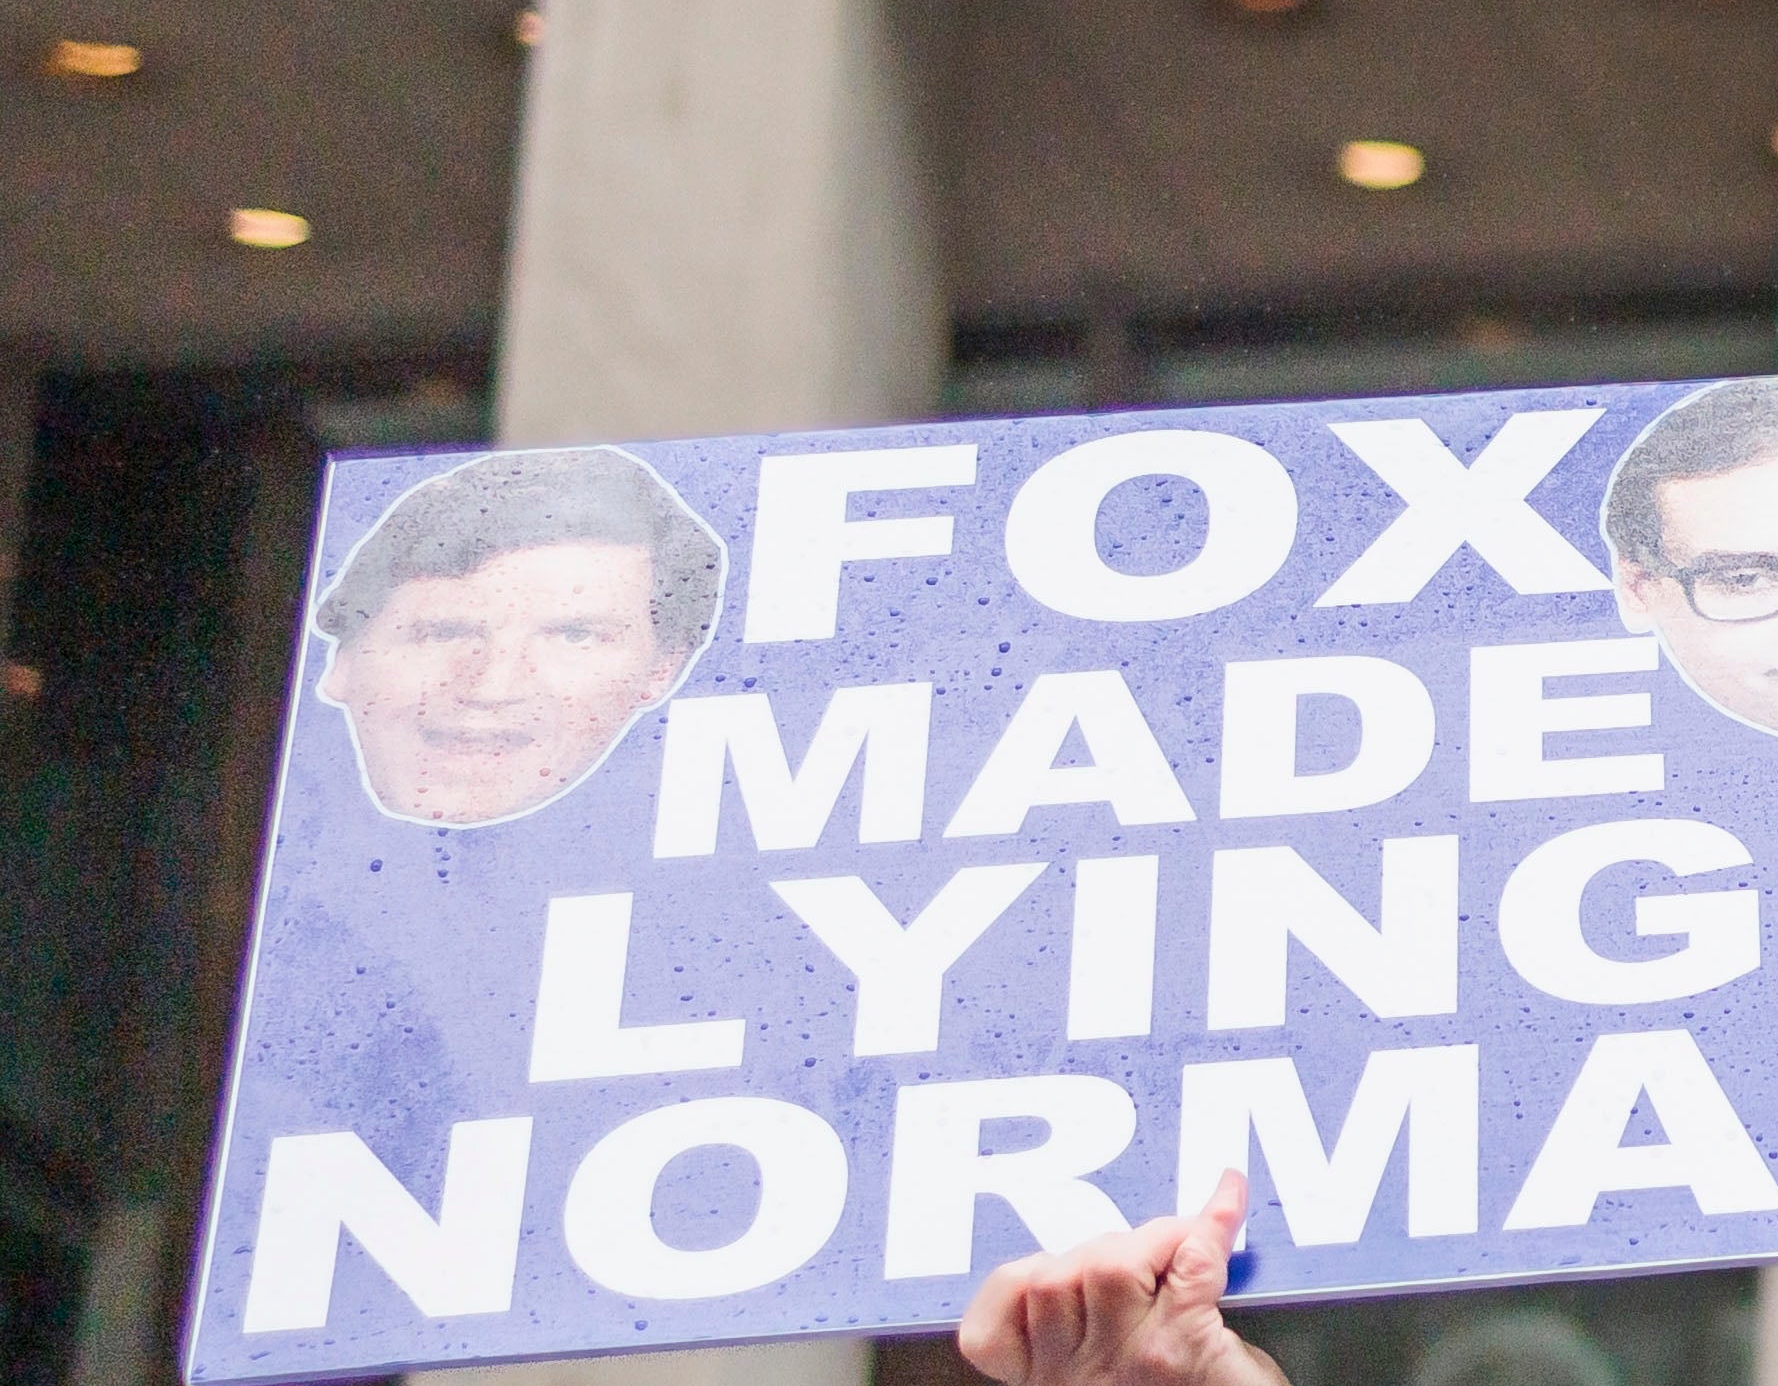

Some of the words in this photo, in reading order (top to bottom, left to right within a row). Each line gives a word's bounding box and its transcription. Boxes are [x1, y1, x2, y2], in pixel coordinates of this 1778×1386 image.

[742, 407, 1614, 644] FOX
[653, 636, 1667, 860] MADE
[528, 817, 1763, 1083] LYING
